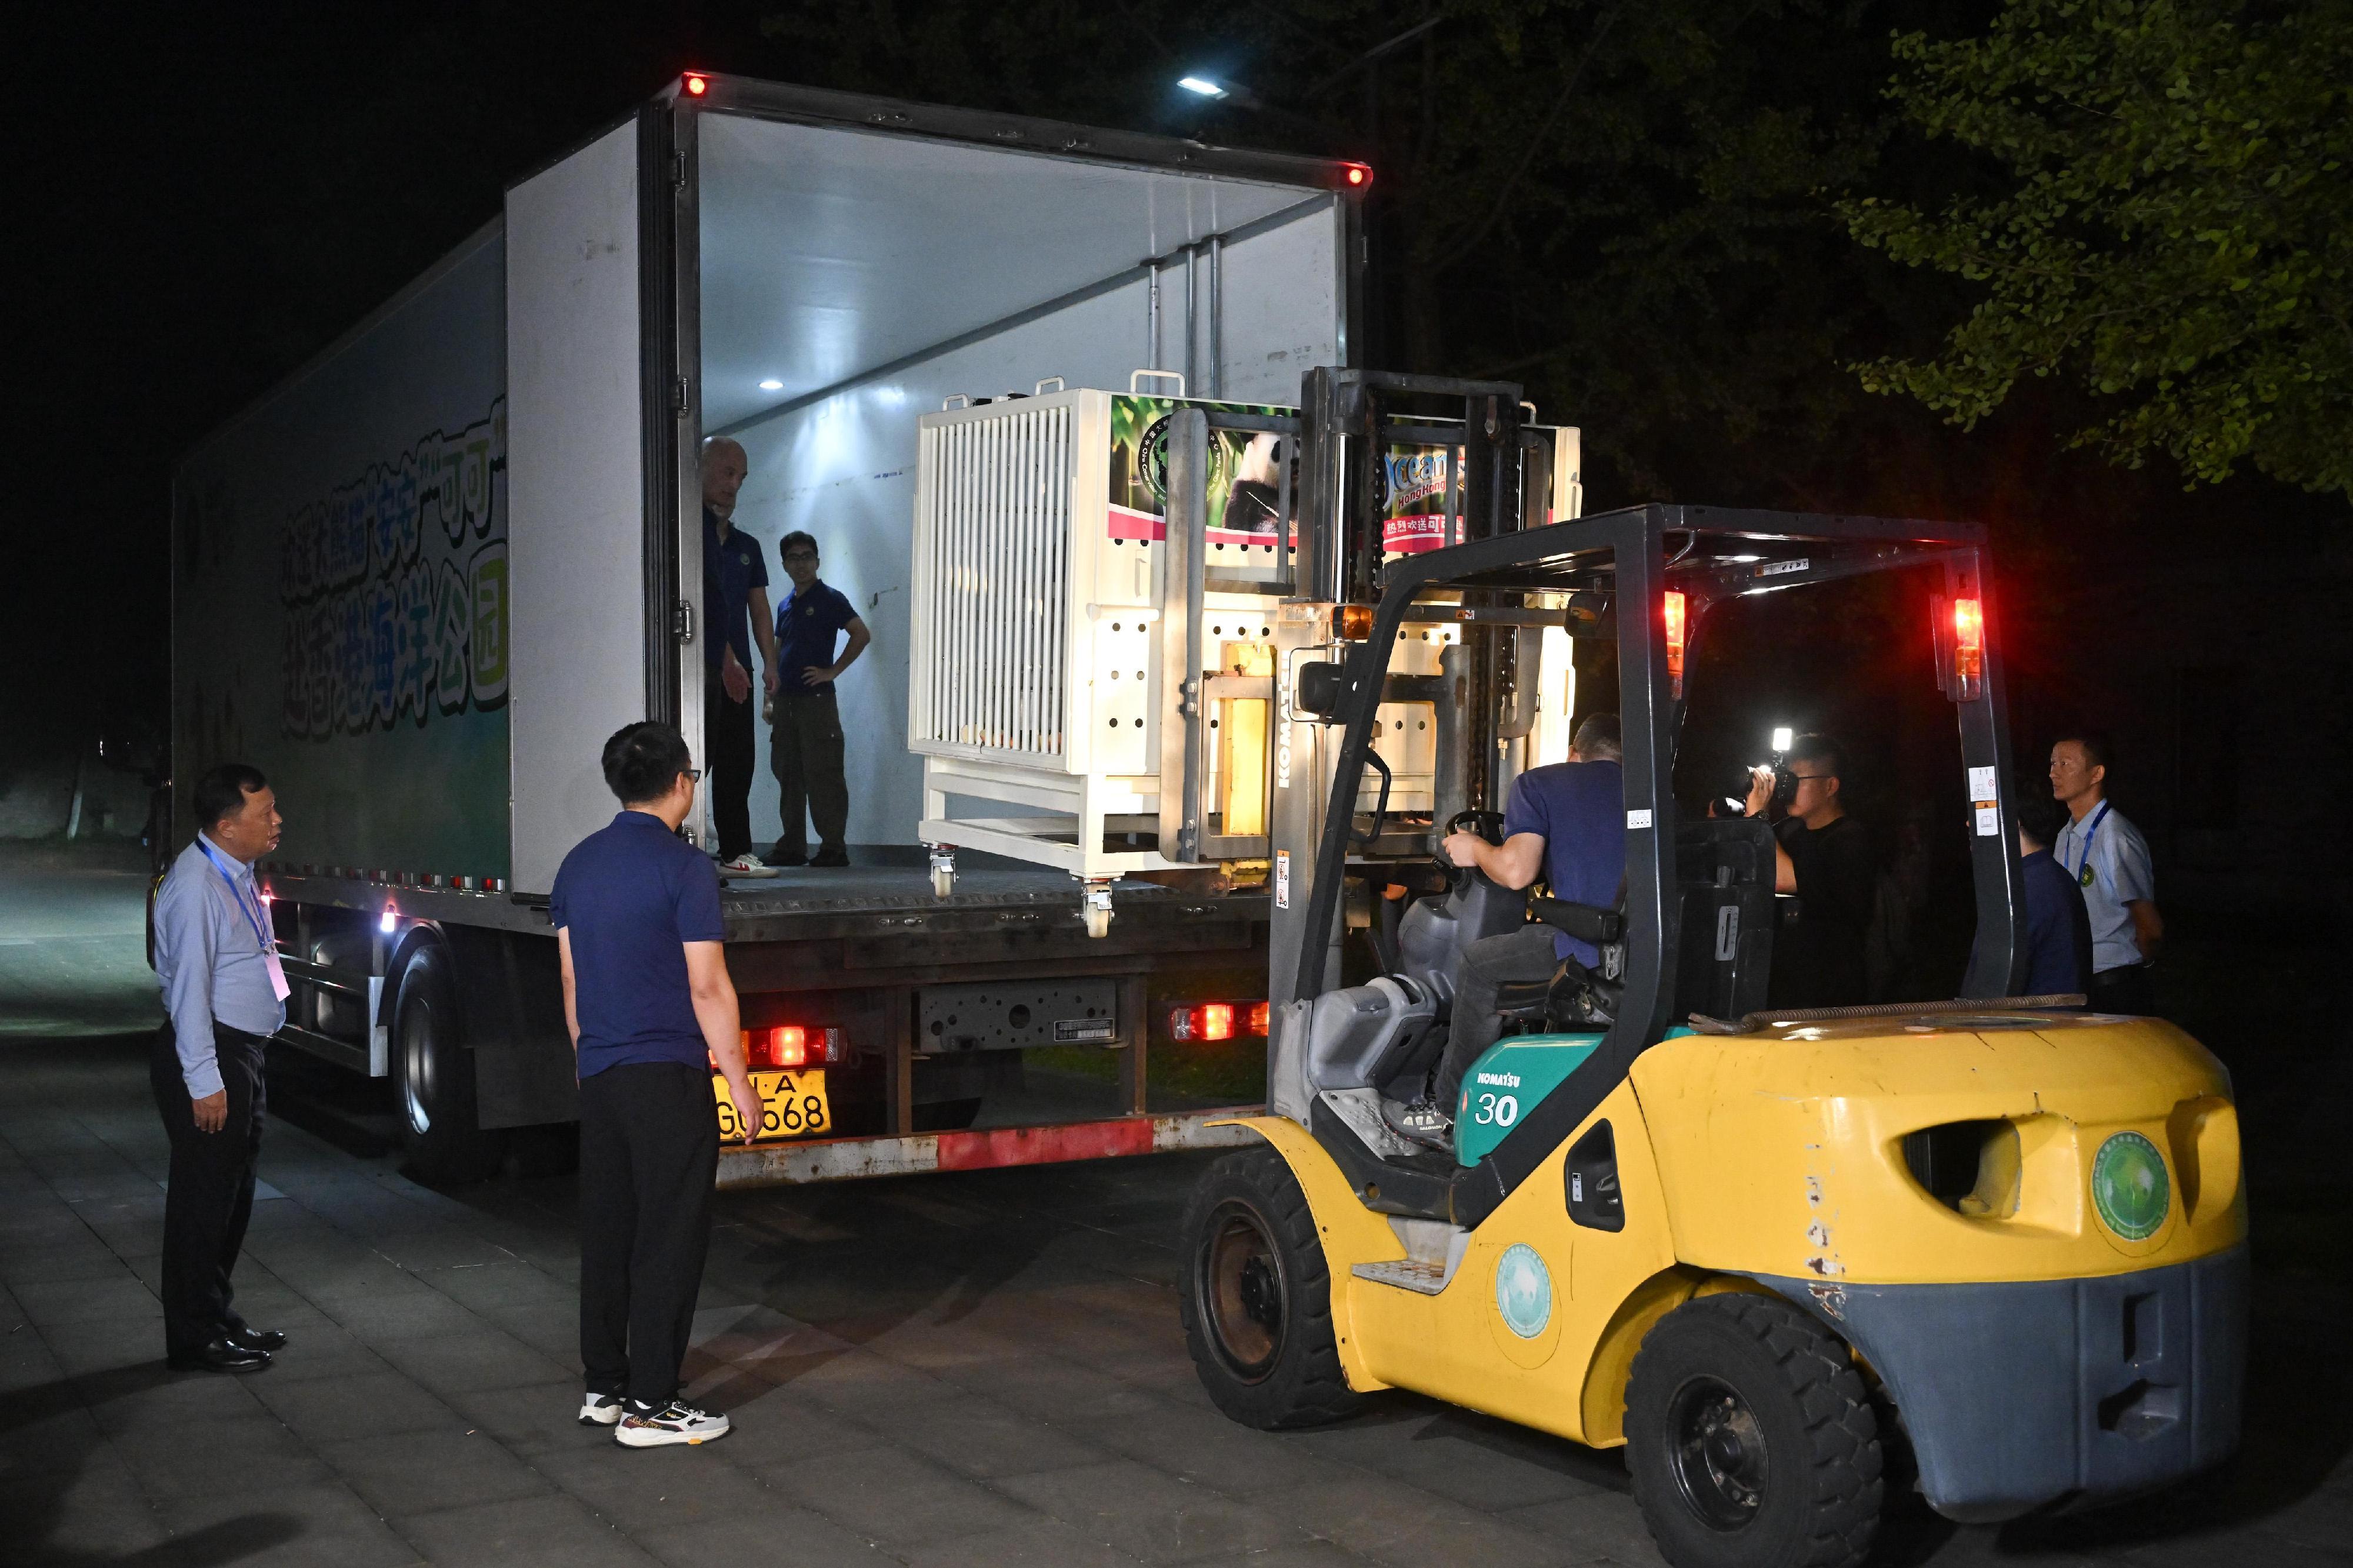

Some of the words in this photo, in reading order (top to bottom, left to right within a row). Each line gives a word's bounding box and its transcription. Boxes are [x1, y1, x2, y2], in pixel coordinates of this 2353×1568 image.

[1142, 464, 1158, 495] Conservation
[1158, 493, 1166, 502] and
[1397, 488, 1422, 509] Hong
[1422, 479, 1447, 496] Kong
[1278, 650, 1291, 788] KOMATSU
[1477, 1072, 1520, 1087] KOMATSU
[1475, 1093, 1518, 1127] 30
